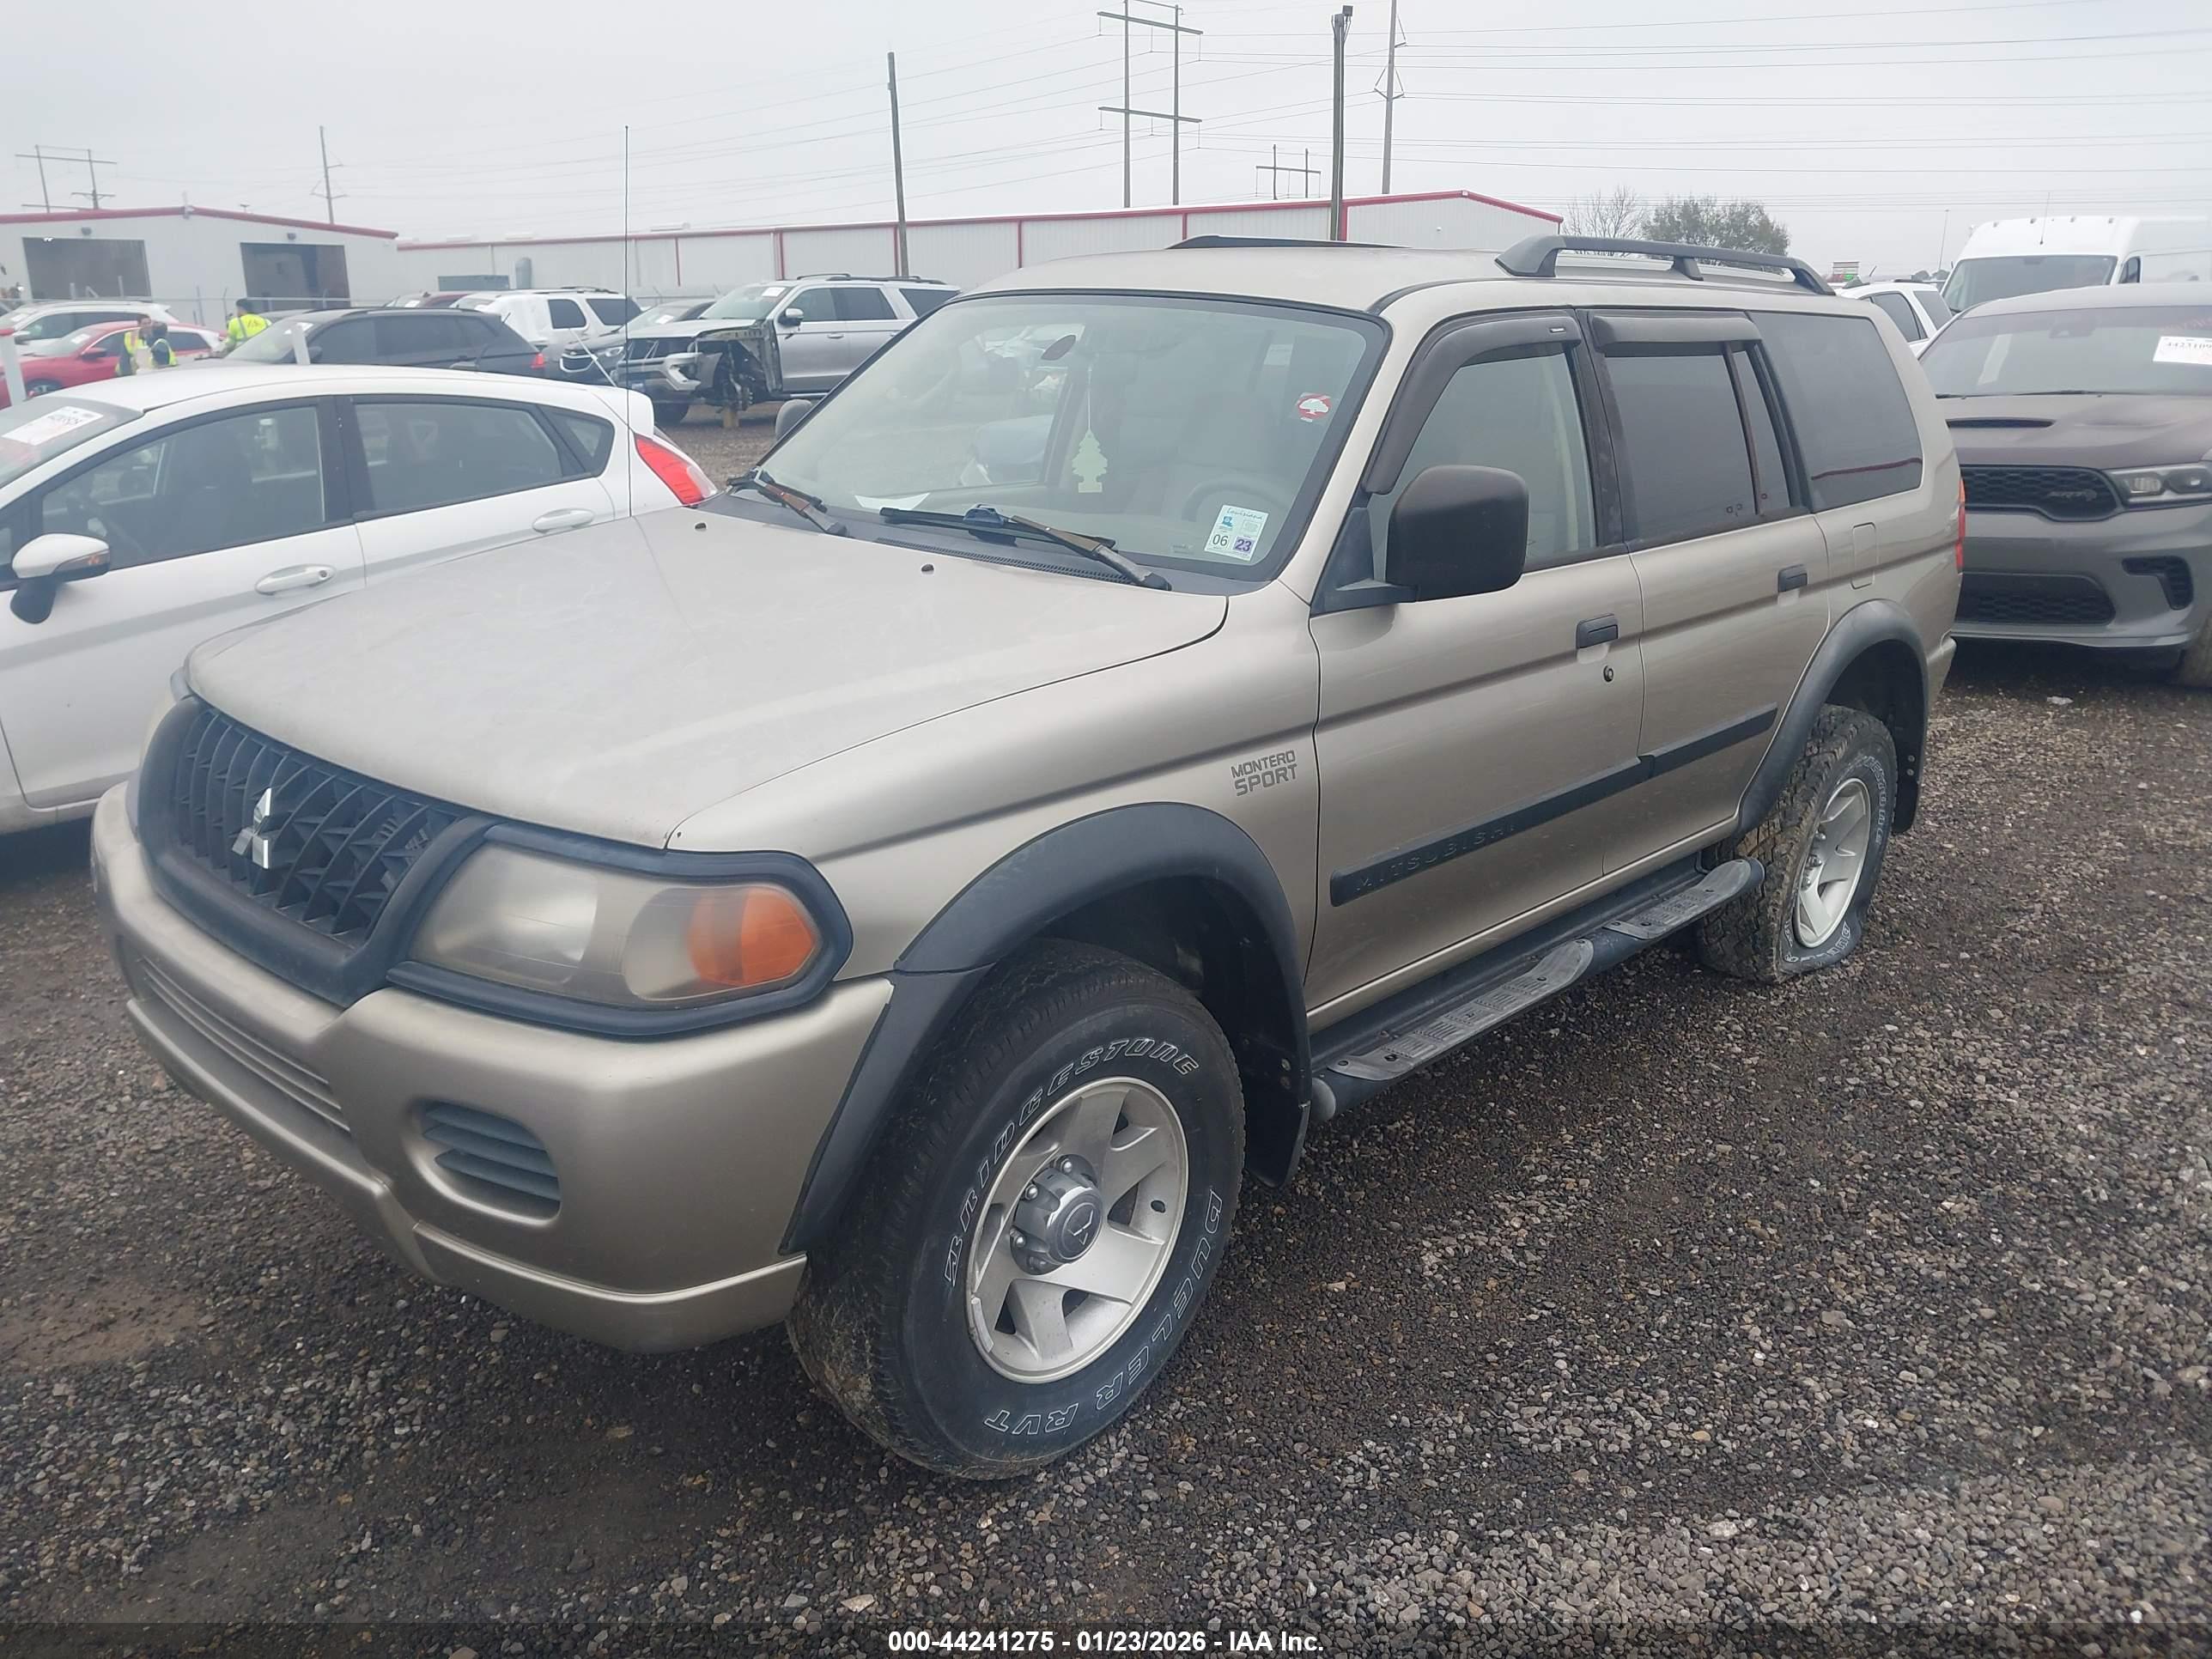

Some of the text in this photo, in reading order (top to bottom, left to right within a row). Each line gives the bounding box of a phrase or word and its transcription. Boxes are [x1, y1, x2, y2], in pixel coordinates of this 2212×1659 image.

[1212, 534, 1252, 552] 06 23
[1231, 749, 1296, 778] MONTERO
[1234, 763, 1297, 797] SPORT
[944, 1037, 1200, 1286] BRIDGESTONE
[984, 1188, 1223, 1435] DUELER RVT
